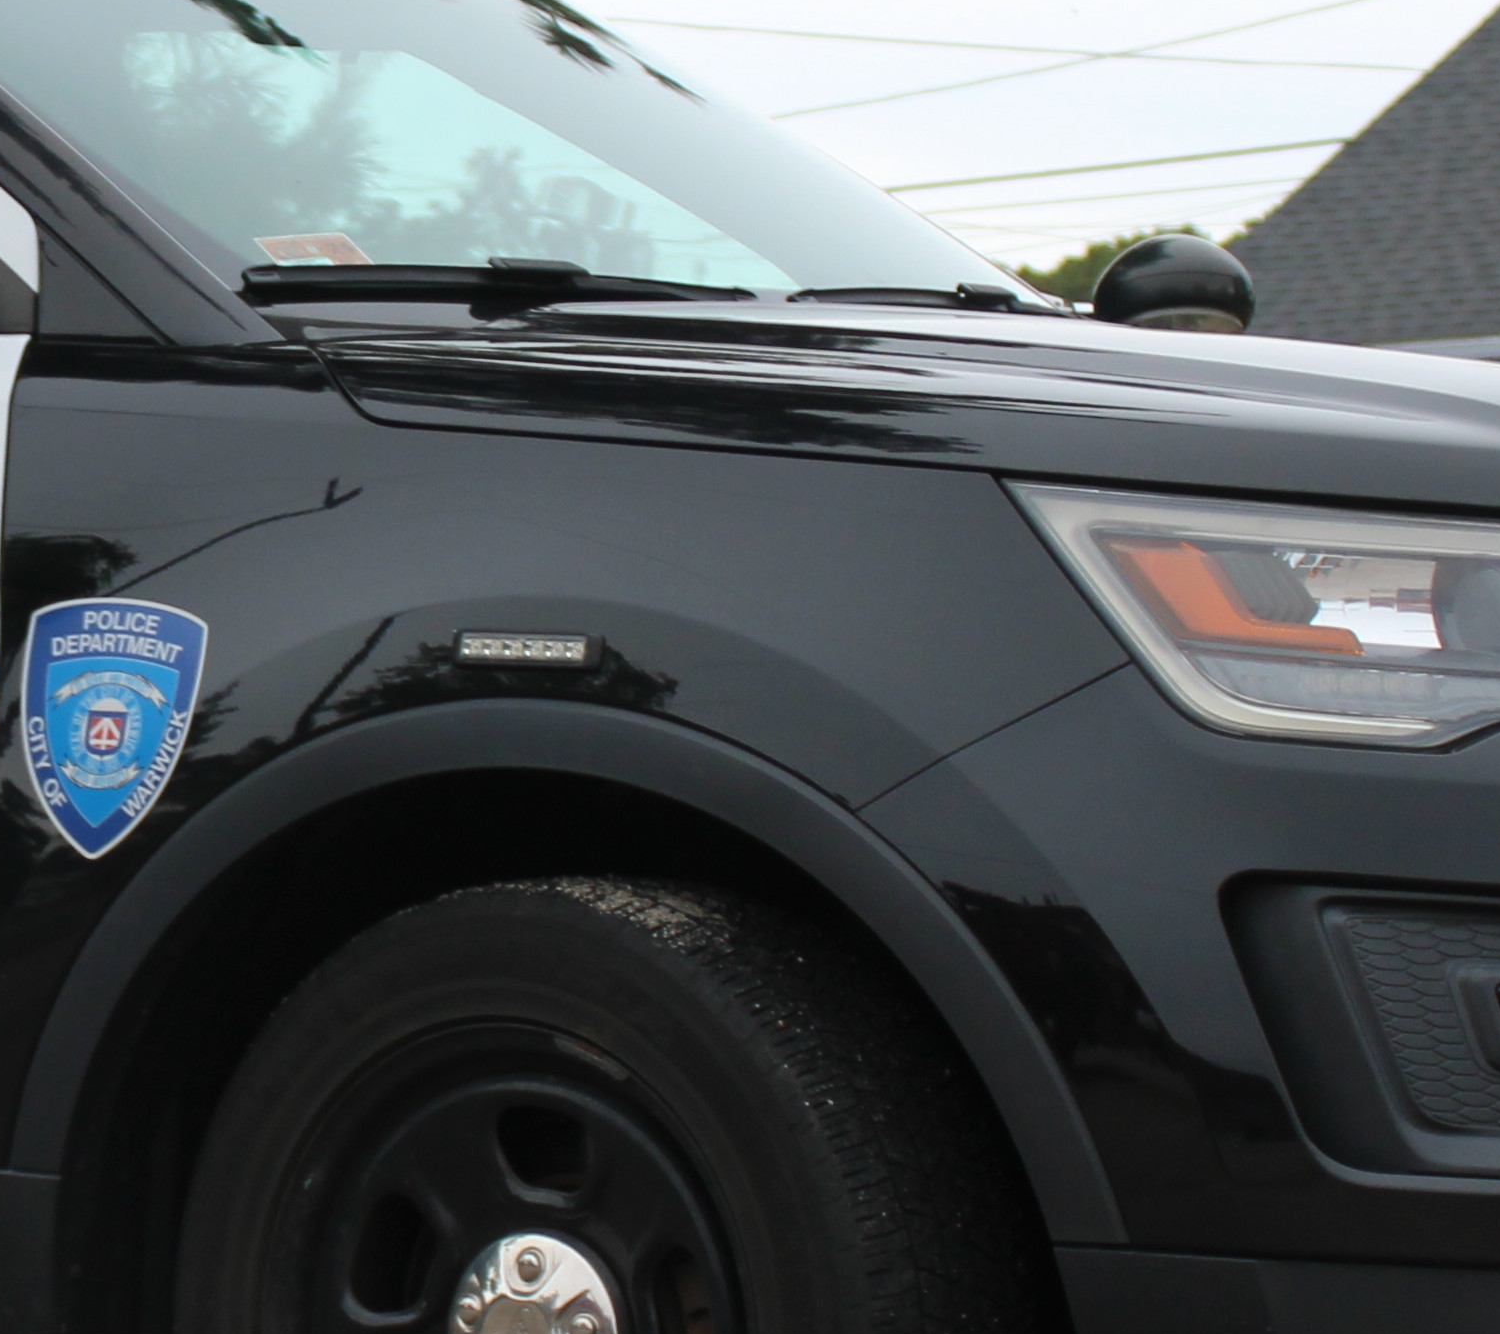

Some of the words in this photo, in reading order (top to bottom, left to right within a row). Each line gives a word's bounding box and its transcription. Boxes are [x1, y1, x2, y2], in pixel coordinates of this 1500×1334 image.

[52, 633, 182, 663] DEPARTMENT
[83, 610, 160, 634] POLICE
[28, 716, 52, 769] CITY
[43, 778, 68, 808] OF
[120, 709, 188, 818] WARWICK
